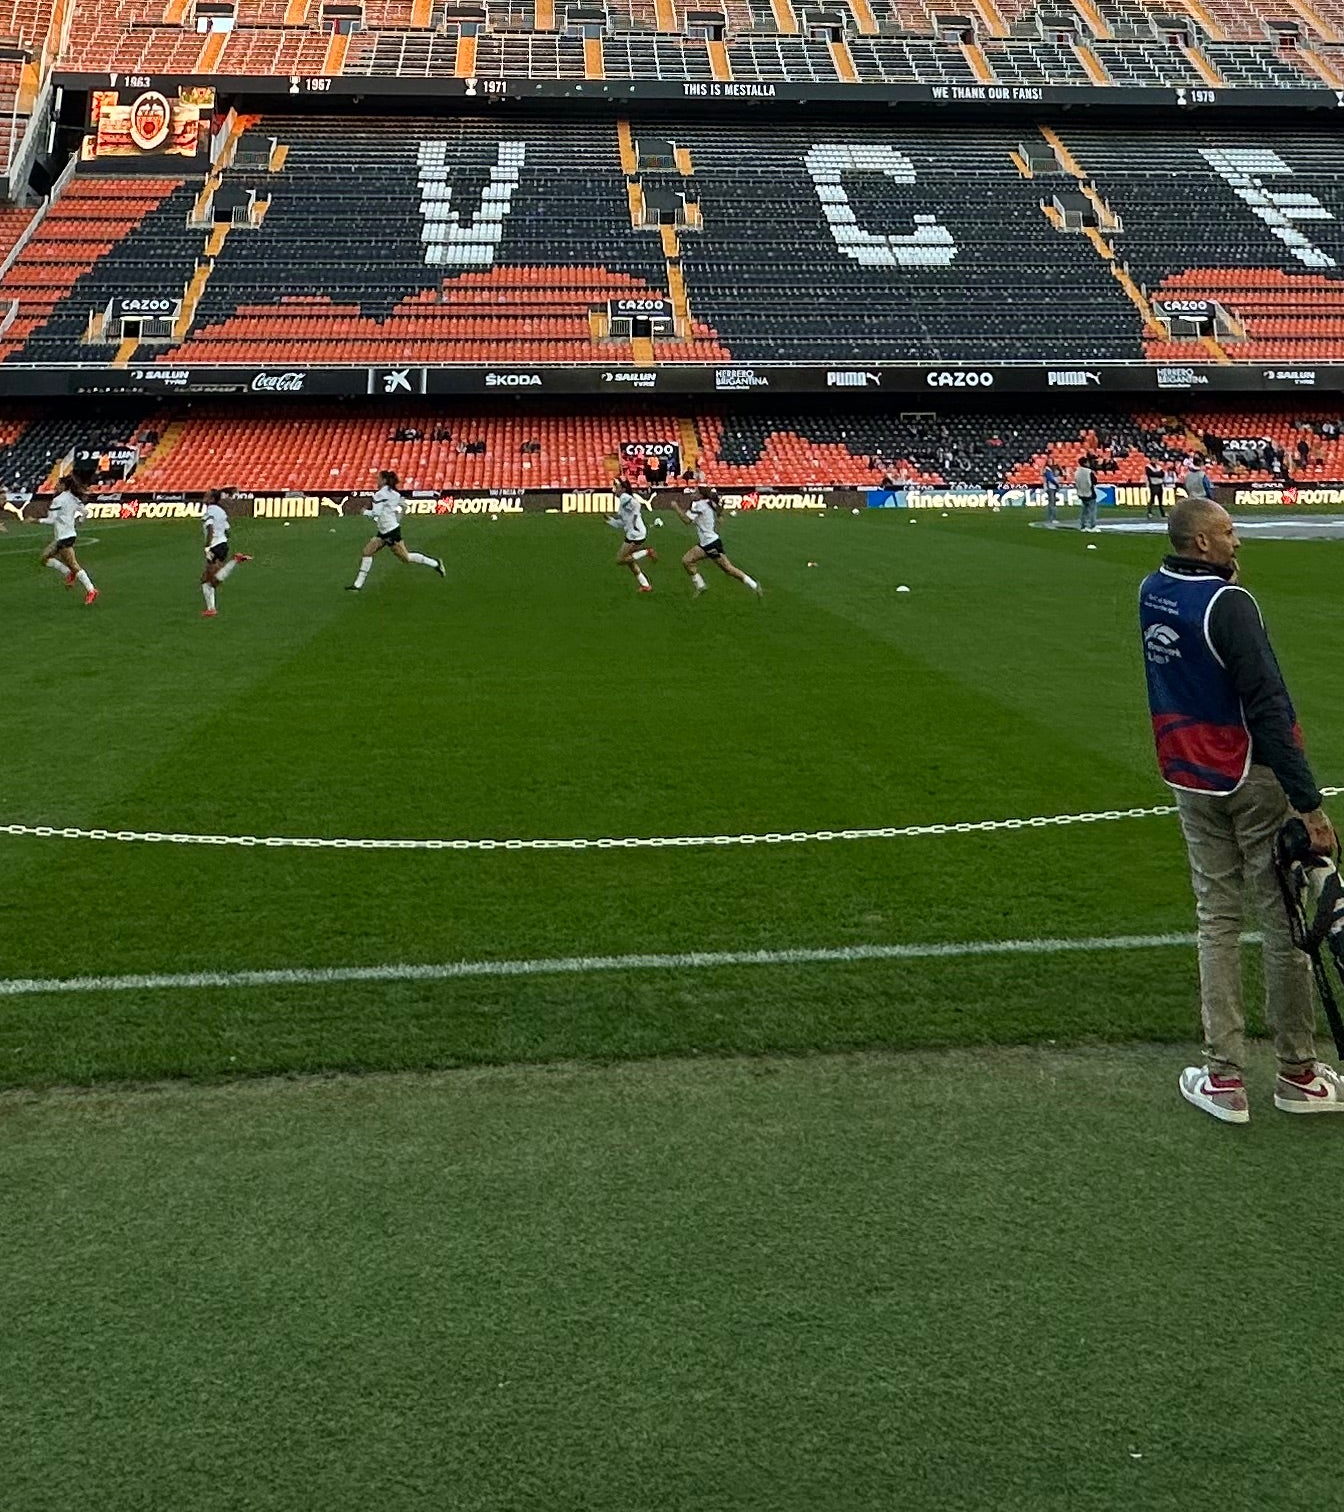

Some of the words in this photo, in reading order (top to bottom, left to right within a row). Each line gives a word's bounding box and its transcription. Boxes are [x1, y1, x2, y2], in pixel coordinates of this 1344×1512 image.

[306, 78, 332, 91] 1967
[483, 80, 507, 93] 1971
[683, 83, 707, 96] THIS
[710, 84, 722, 96] IS
[724, 84, 776, 97] MESTALLA
[932, 87, 949, 99] WE
[951, 87, 986, 100] THANK
[988, 88, 1010, 100] OUR
[1012, 88, 1043, 100] FANS!
[1190, 90, 1216, 103] 1979
[121, 299, 170, 311] CAZOO
[618, 300, 665, 311] CAZOO
[1163, 300, 1208, 311] CAZOO
[144, 371, 190, 380] SAILUN
[485, 373, 543, 386] ŠKODA
[827, 371, 869, 386] PUMA
[926, 372, 994, 387] CAZOO
[1047, 371, 1089, 386] PUMA
[561, 492, 620, 513] PUM
[758, 493, 827, 510] FOOTBALL
[906, 489, 1001, 509] finetwork
[1235, 490, 1284, 505] FASTER
[137, 501, 208, 519] FOOTBALL
[253, 496, 320, 519] PUMA
[452, 496, 524, 514] FOOTBALL
